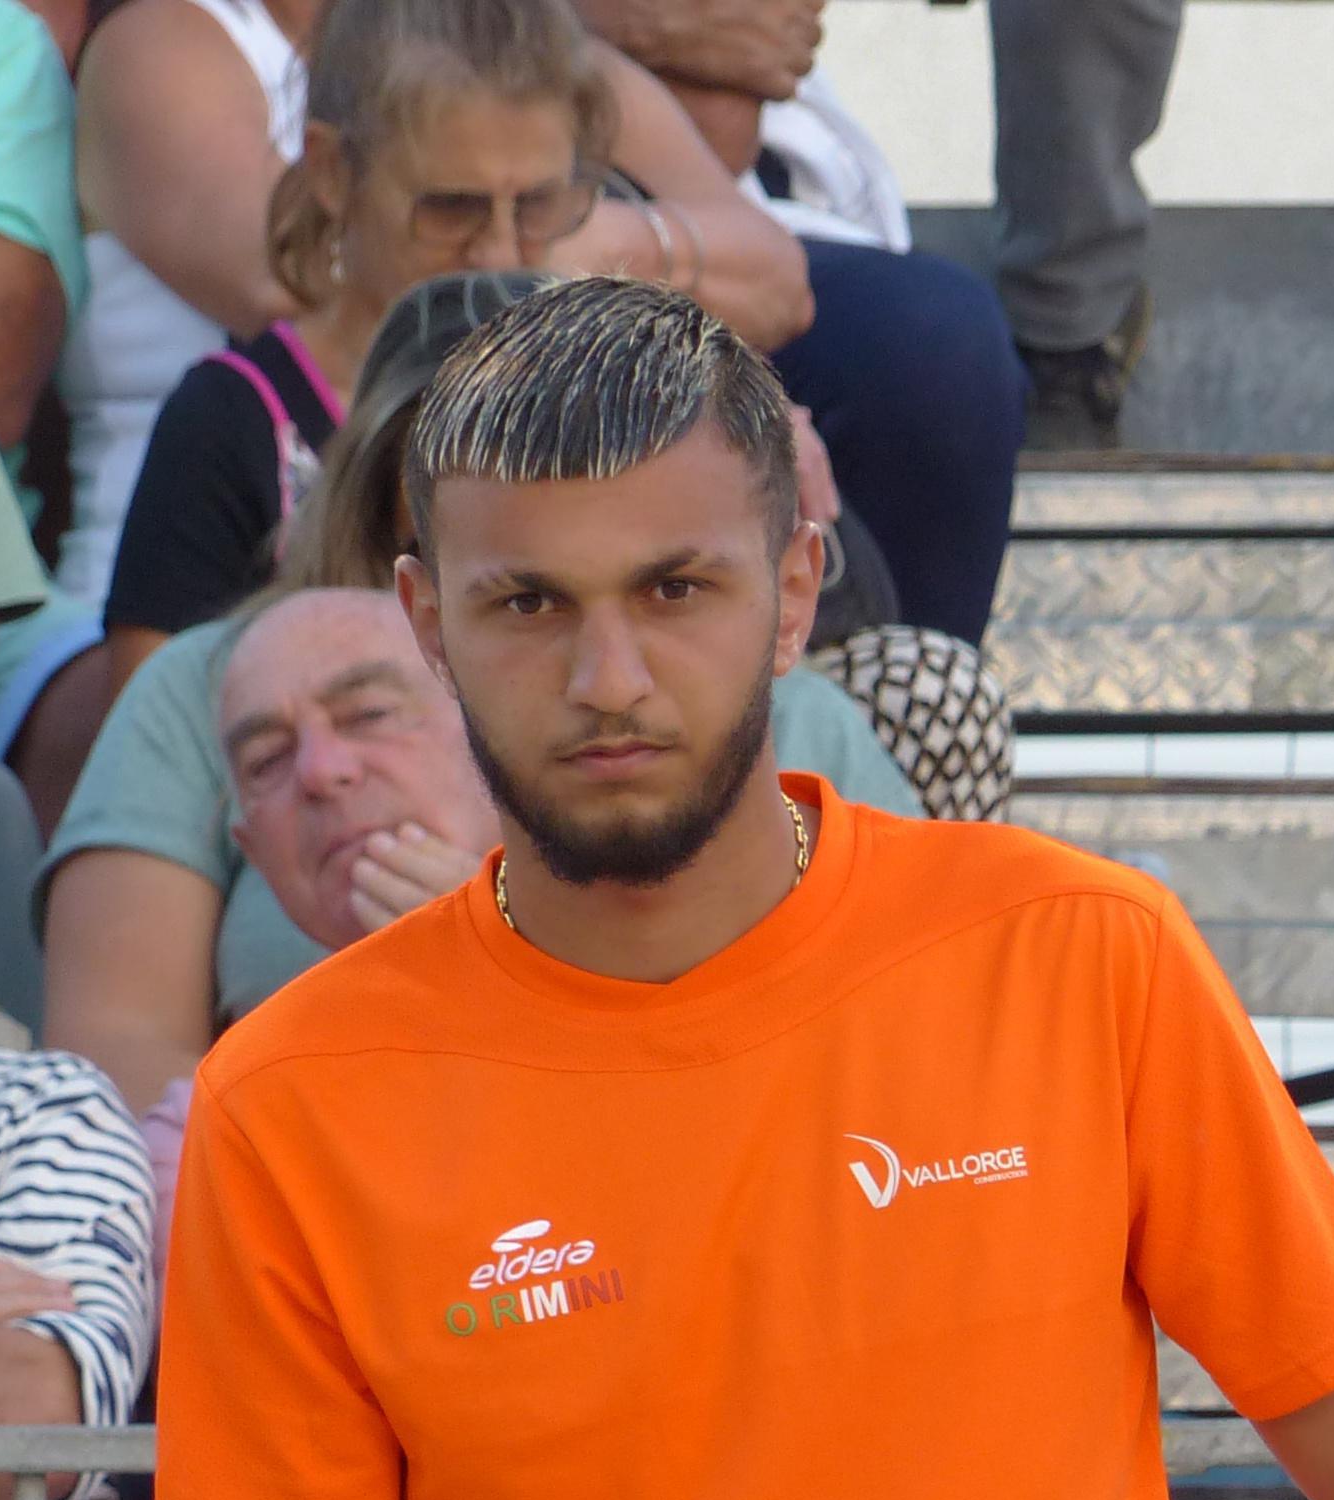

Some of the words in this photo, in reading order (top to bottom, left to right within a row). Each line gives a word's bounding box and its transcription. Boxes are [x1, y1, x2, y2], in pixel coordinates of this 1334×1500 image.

[902, 1146, 1027, 1188] VALLORGE
[469, 1239, 595, 1290] eldera
[445, 1302, 478, 1337] O
[490, 1267, 624, 1329] RIMINI
